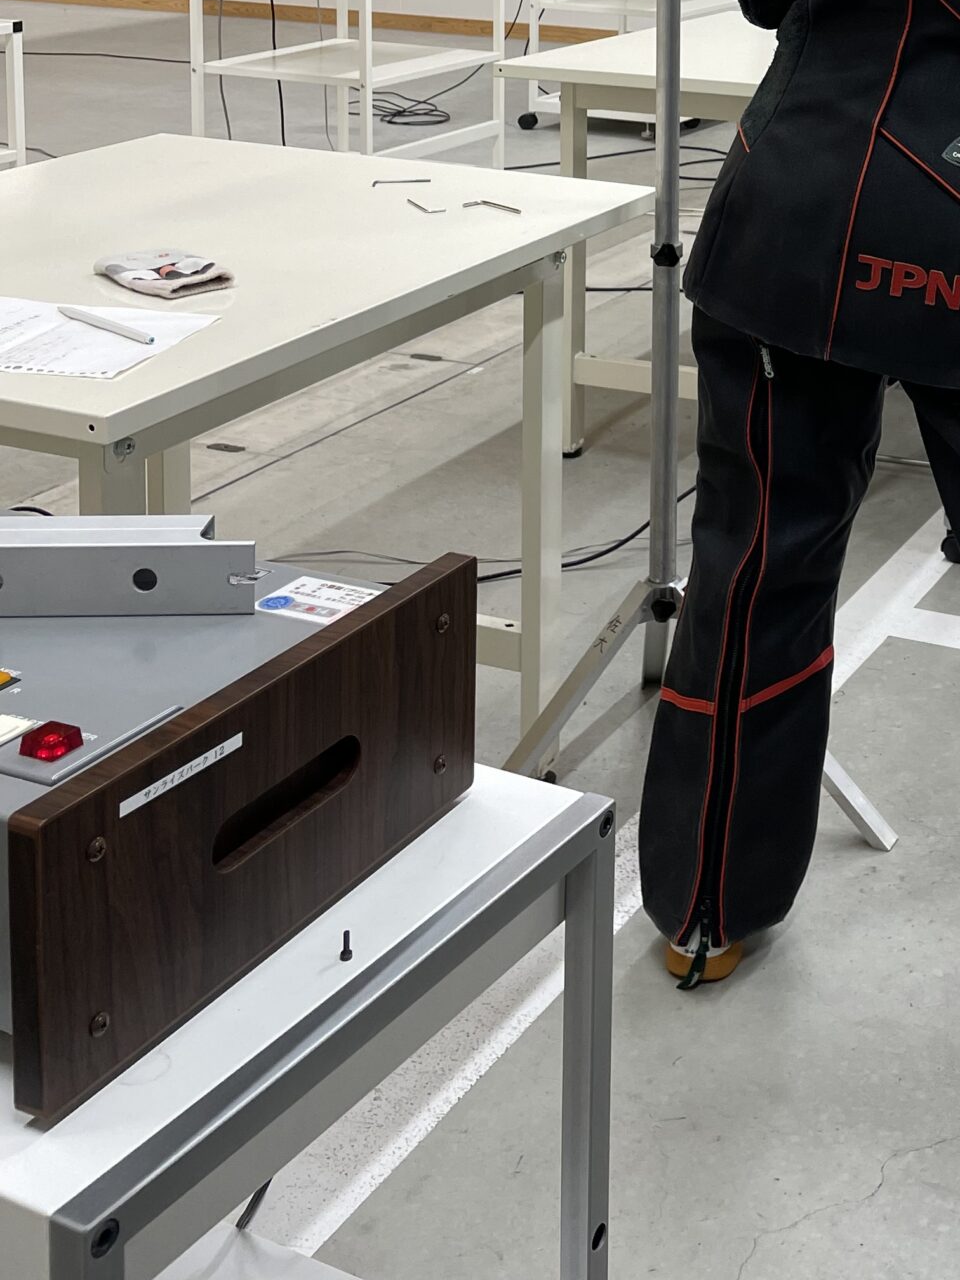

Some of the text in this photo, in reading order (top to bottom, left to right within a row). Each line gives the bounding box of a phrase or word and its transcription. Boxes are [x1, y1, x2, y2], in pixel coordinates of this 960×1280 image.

[143, 745, 225, 799] サンライズパーク 12
